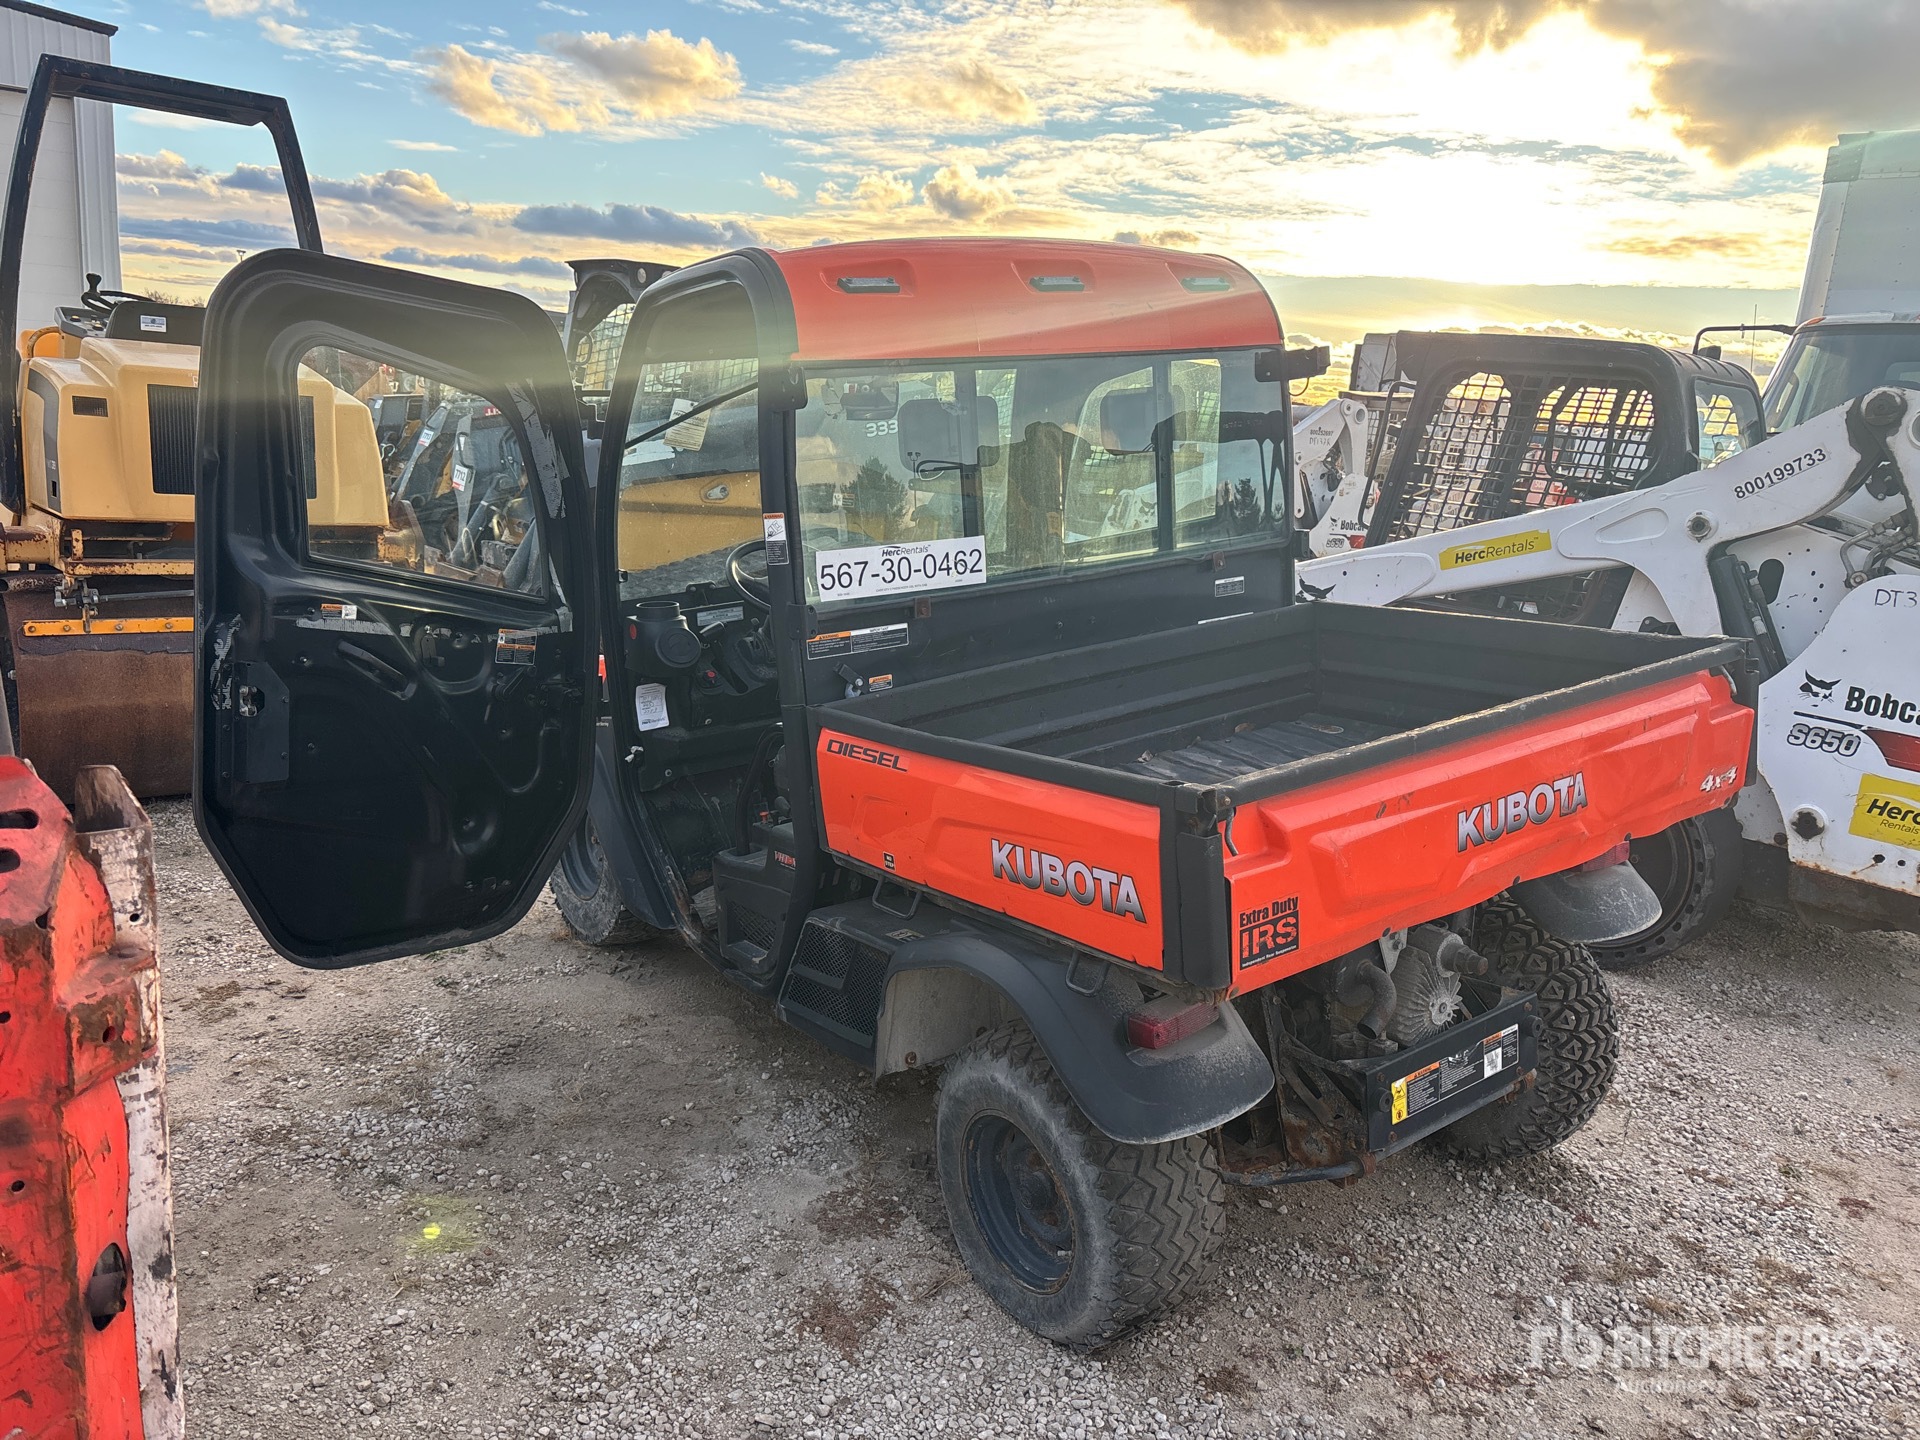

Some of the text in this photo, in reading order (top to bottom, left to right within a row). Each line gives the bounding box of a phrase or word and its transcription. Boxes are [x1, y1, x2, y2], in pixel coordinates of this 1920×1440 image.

[866, 420, 898, 437] 333
[1734, 448, 1826, 499] 800199733
[821, 548, 983, 591] 567-30-0462
[827, 739, 908, 773] DIESEL
[1787, 723, 1861, 757] S650
[1457, 770, 1588, 853] KUBOTA
[990, 838, 1147, 924] KUBOTA
[1240, 896, 1299, 928] Extra Duty
[1242, 916, 1298, 959] IRS
